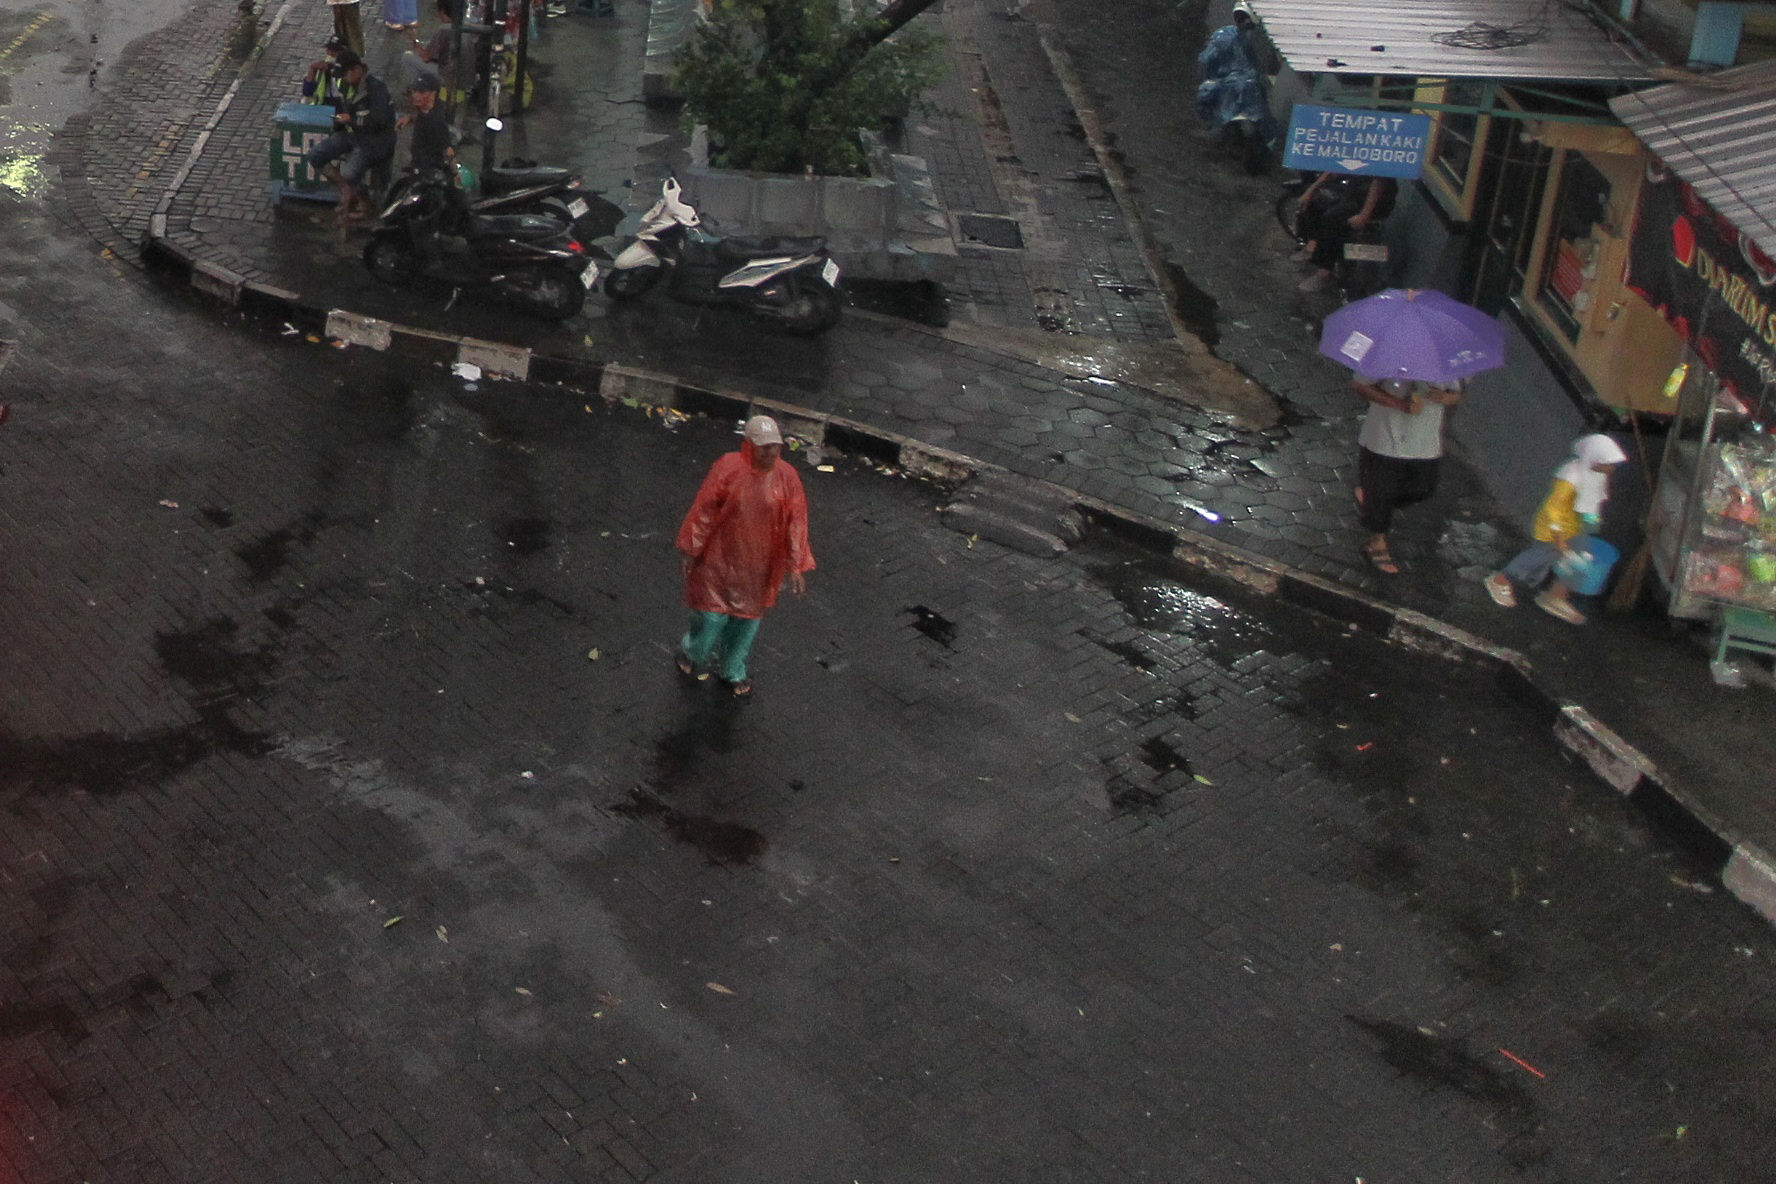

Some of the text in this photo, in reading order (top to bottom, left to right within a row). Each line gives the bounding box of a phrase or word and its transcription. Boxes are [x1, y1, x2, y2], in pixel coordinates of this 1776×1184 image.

[1319, 112, 1403, 132] TEMPAT
[1294, 127, 1422, 149] PEJALAN KAKI
[1291, 142, 1419, 164] KE MALIOBORO
